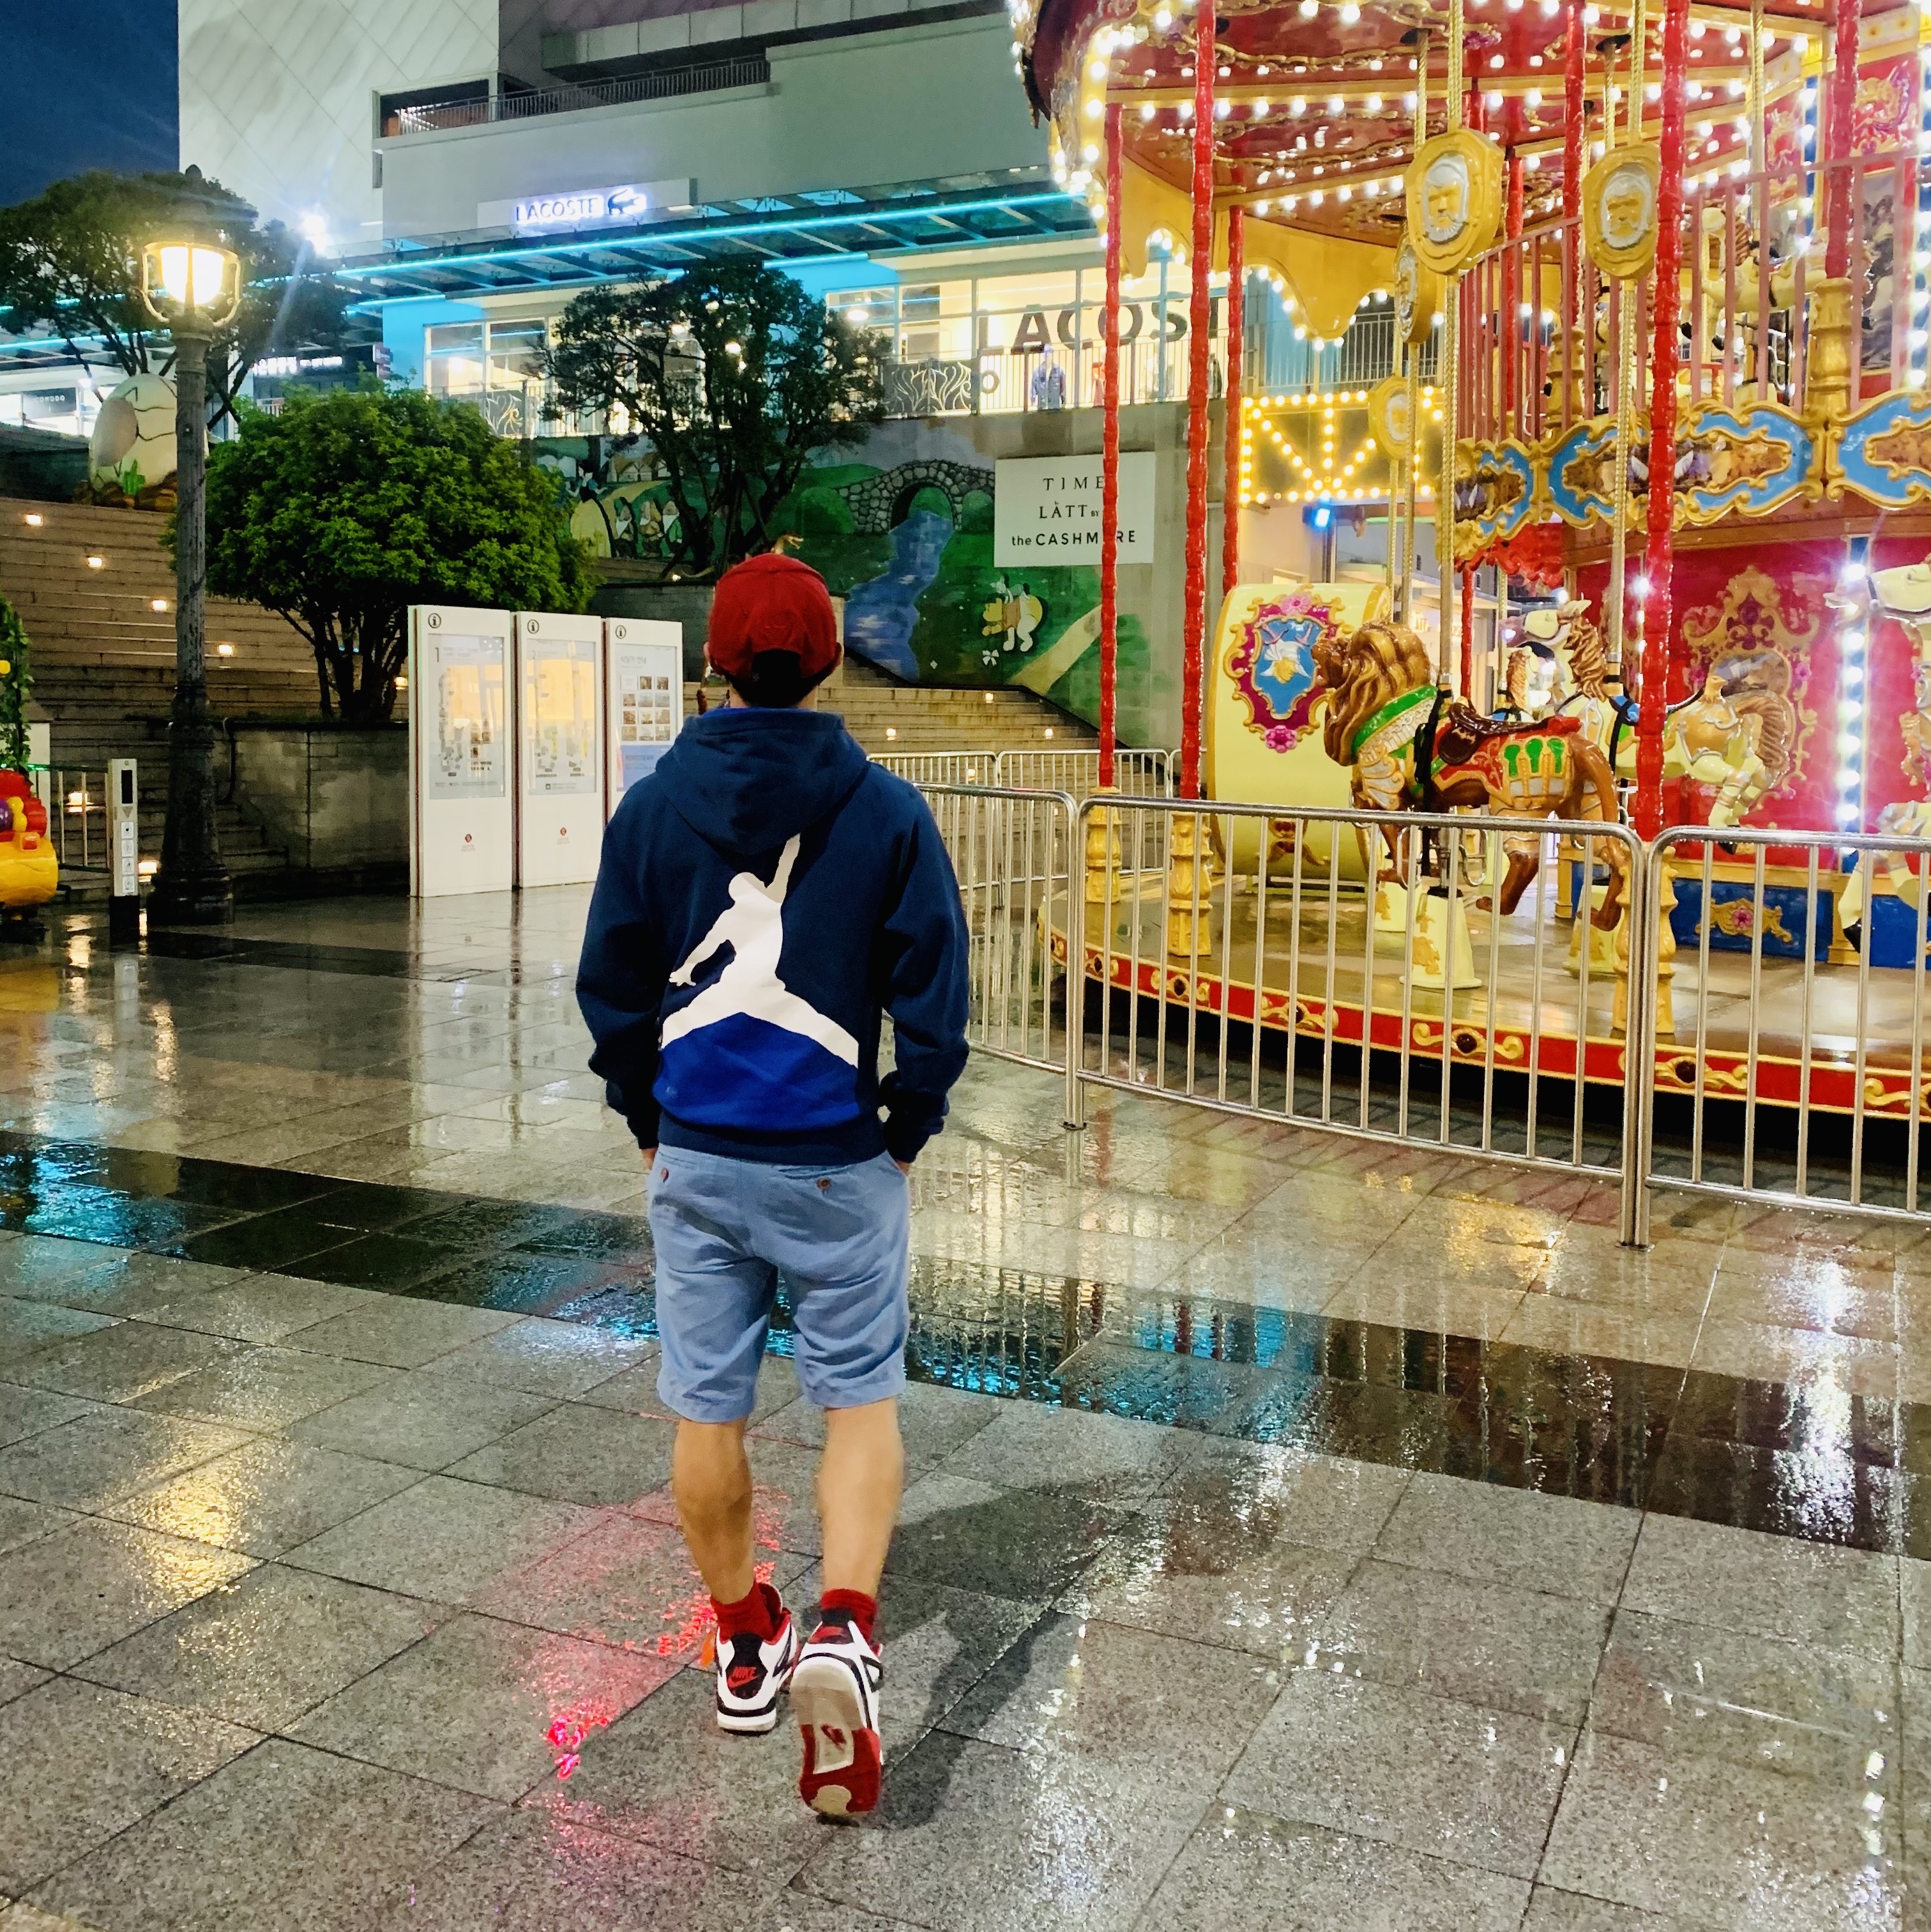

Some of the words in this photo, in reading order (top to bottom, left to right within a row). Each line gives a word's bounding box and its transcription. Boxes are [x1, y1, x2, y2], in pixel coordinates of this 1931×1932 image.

[515, 197, 599, 222] LACOSTE
[1043, 475, 1105, 491] TIME
[1011, 535, 1032, 546] the
[1035, 529, 1136, 546] CASHMRE
[732, 1666, 757, 1679] NIKE
